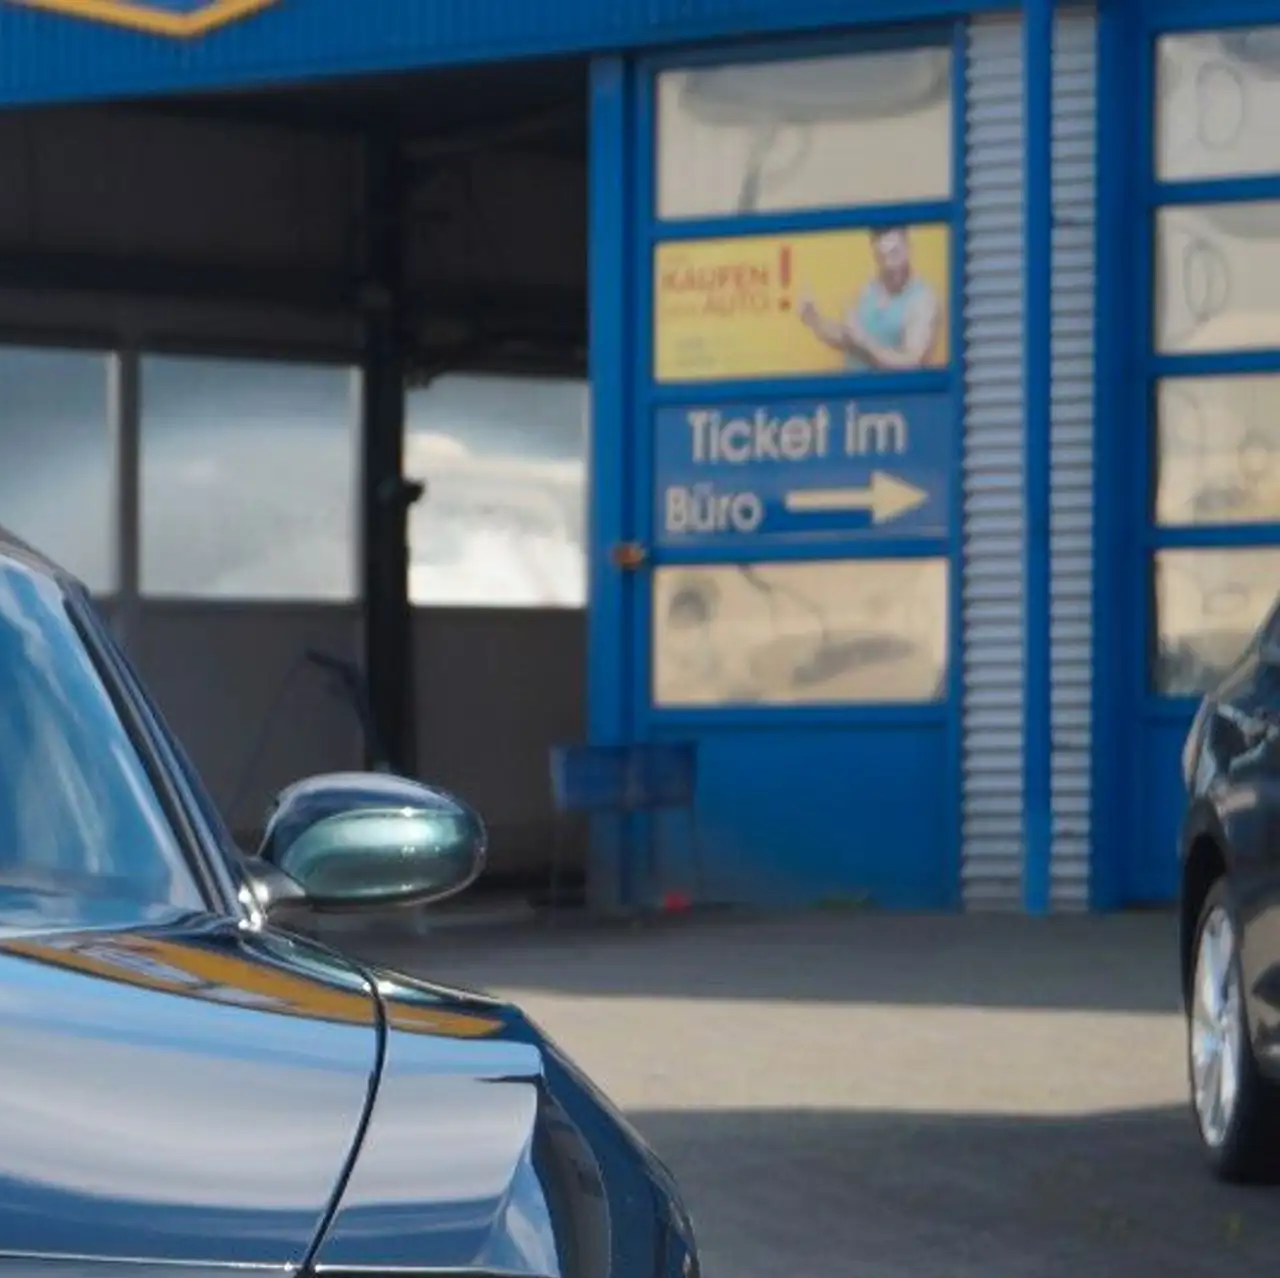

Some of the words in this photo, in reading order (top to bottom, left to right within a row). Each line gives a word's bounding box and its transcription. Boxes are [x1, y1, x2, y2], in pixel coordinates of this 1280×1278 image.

[689, 404, 830, 465] Ticket
[845, 401, 908, 457] im
[666, 481, 762, 533] Büro
